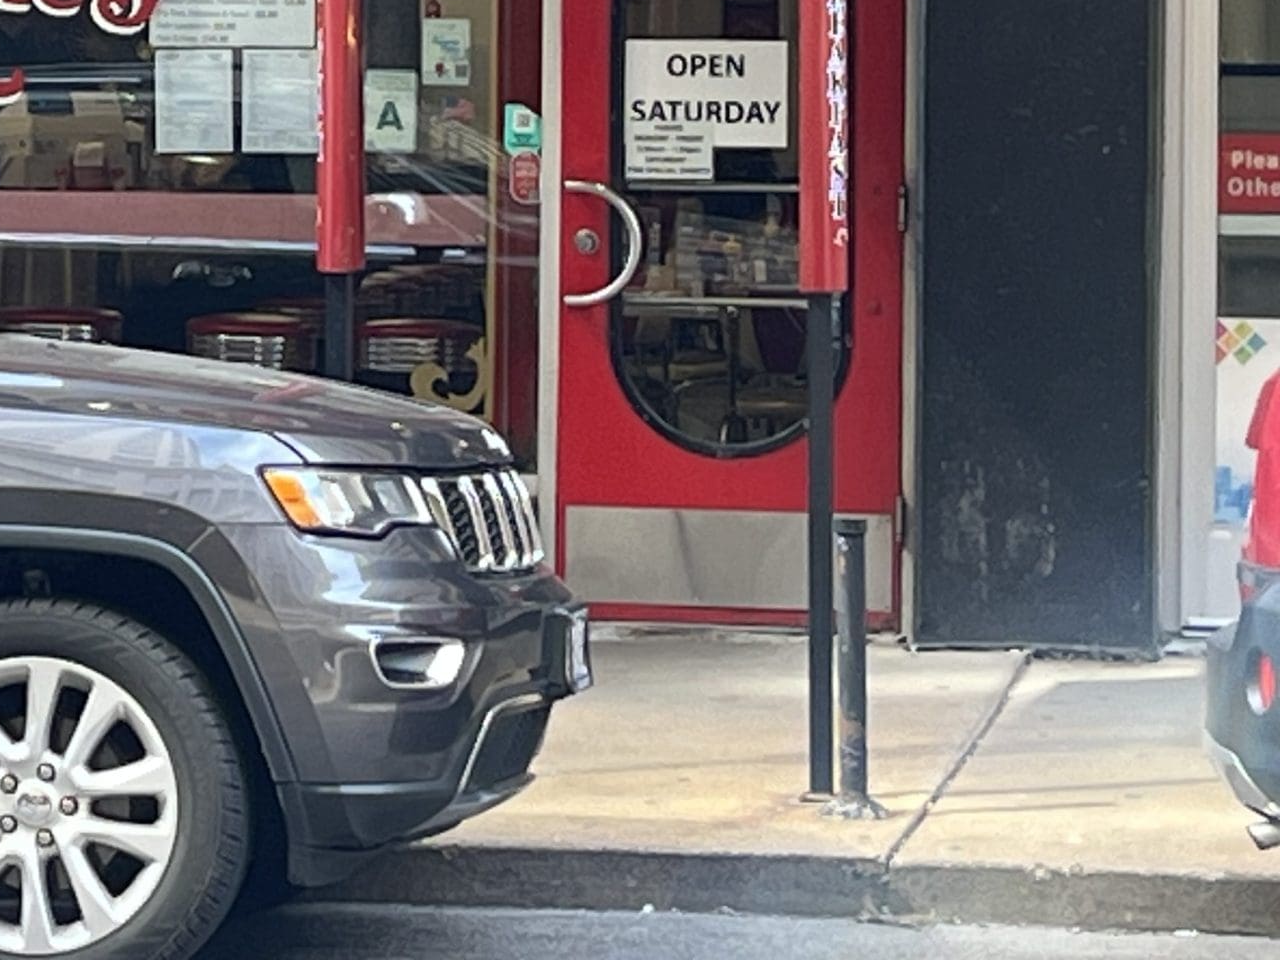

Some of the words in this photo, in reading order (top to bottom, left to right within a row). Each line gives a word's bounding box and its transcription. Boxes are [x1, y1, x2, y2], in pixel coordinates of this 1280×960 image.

[667, 53, 746, 77] OPEN
[376, 100, 404, 132] A
[631, 99, 782, 125] SATURDAY
